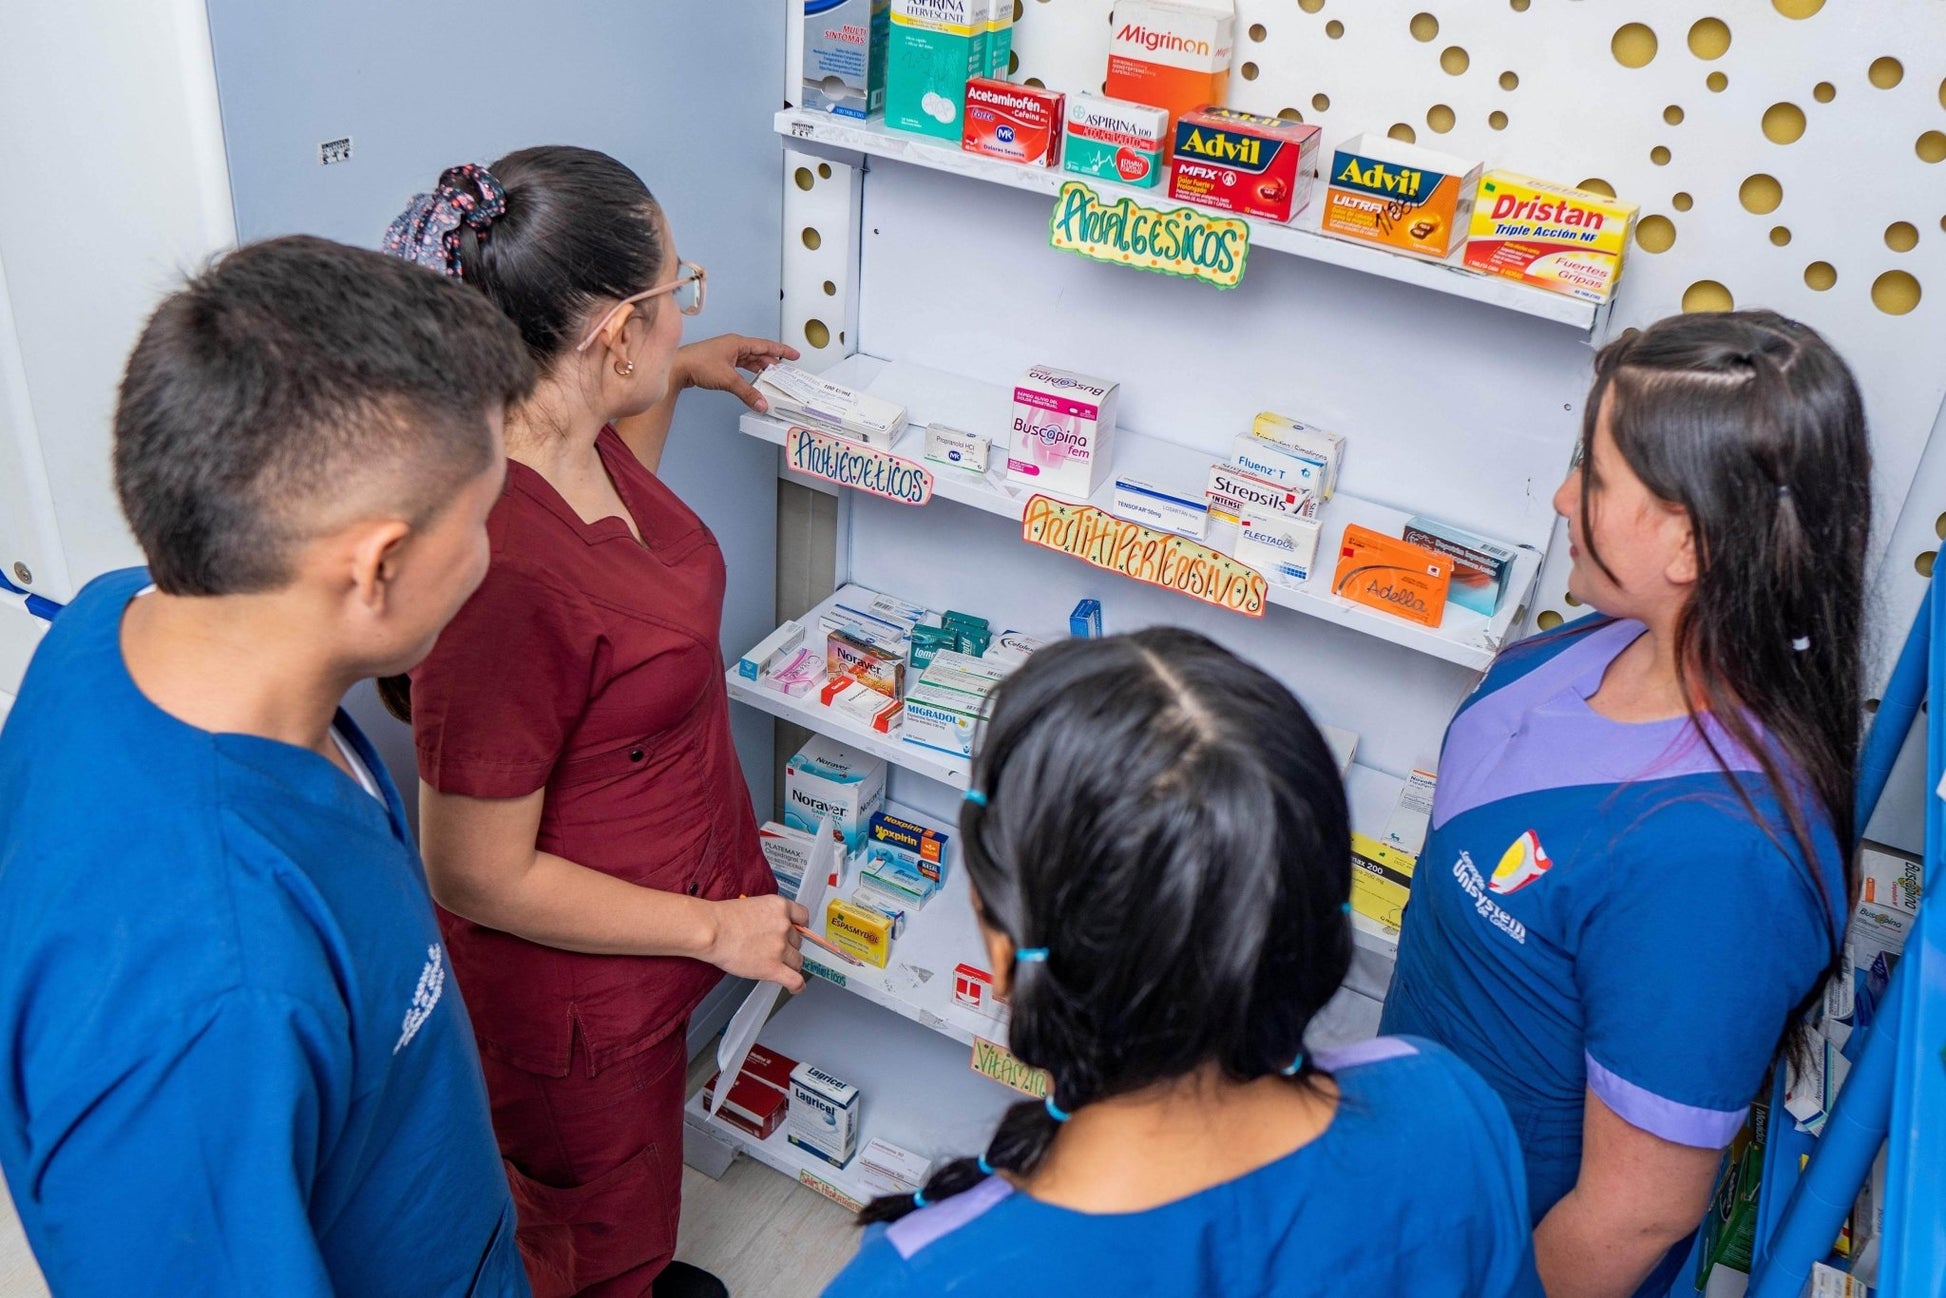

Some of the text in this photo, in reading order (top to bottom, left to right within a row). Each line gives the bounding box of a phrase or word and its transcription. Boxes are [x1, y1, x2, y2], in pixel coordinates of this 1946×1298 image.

[906, 6, 964, 24] EFERVESCENTE
[824, 30, 865, 45] SINTOMAS
[843, 24, 867, 36] MULTI
[1116, 23, 1209, 56] Migrinon
[967, 87, 1041, 113] Acetaminofén
[972, 107, 995, 122] Forte
[997, 129, 1013, 140] MK
[1085, 114, 1152, 138] ASPIRINA 100
[983, 144, 1004, 154] Dolores
[1181, 127, 1260, 165] Advil
[1178, 163, 1218, 180] MAX
[1178, 175, 1193, 185] Dolor
[1193, 178, 1210, 189] Fuerte
[1337, 158, 1422, 196] Advil
[1332, 195, 1383, 213] ULTRA
[1490, 193, 1605, 231] Dristan
[1495, 223, 1598, 243] Triple Acción NF
[1555, 256, 1608, 278] Fuertes
[1558, 270, 1603, 289] Gripas
[1067, 445, 1090, 459] fem
[1238, 455, 1286, 480] Fluenz T
[1213, 476, 1287, 512] Strepsils
[837, 647, 883, 675] Noraver
[907, 704, 957, 725] MIGRADOL
[815, 756, 850, 771] Noraver
[792, 789, 847, 817] Noraver
[883, 815, 923, 834] Noxpirin
[875, 824, 918, 847] Noxpirin
[764, 841, 801, 858] PLATEMAX
[1366, 860, 1384, 876] 200
[1452, 858, 1526, 938] Unisystem
[831, 917, 880, 944] ESPASMYDOL
[807, 1066, 848, 1091] Lagricel
[795, 1087, 836, 1117] Lagricel
